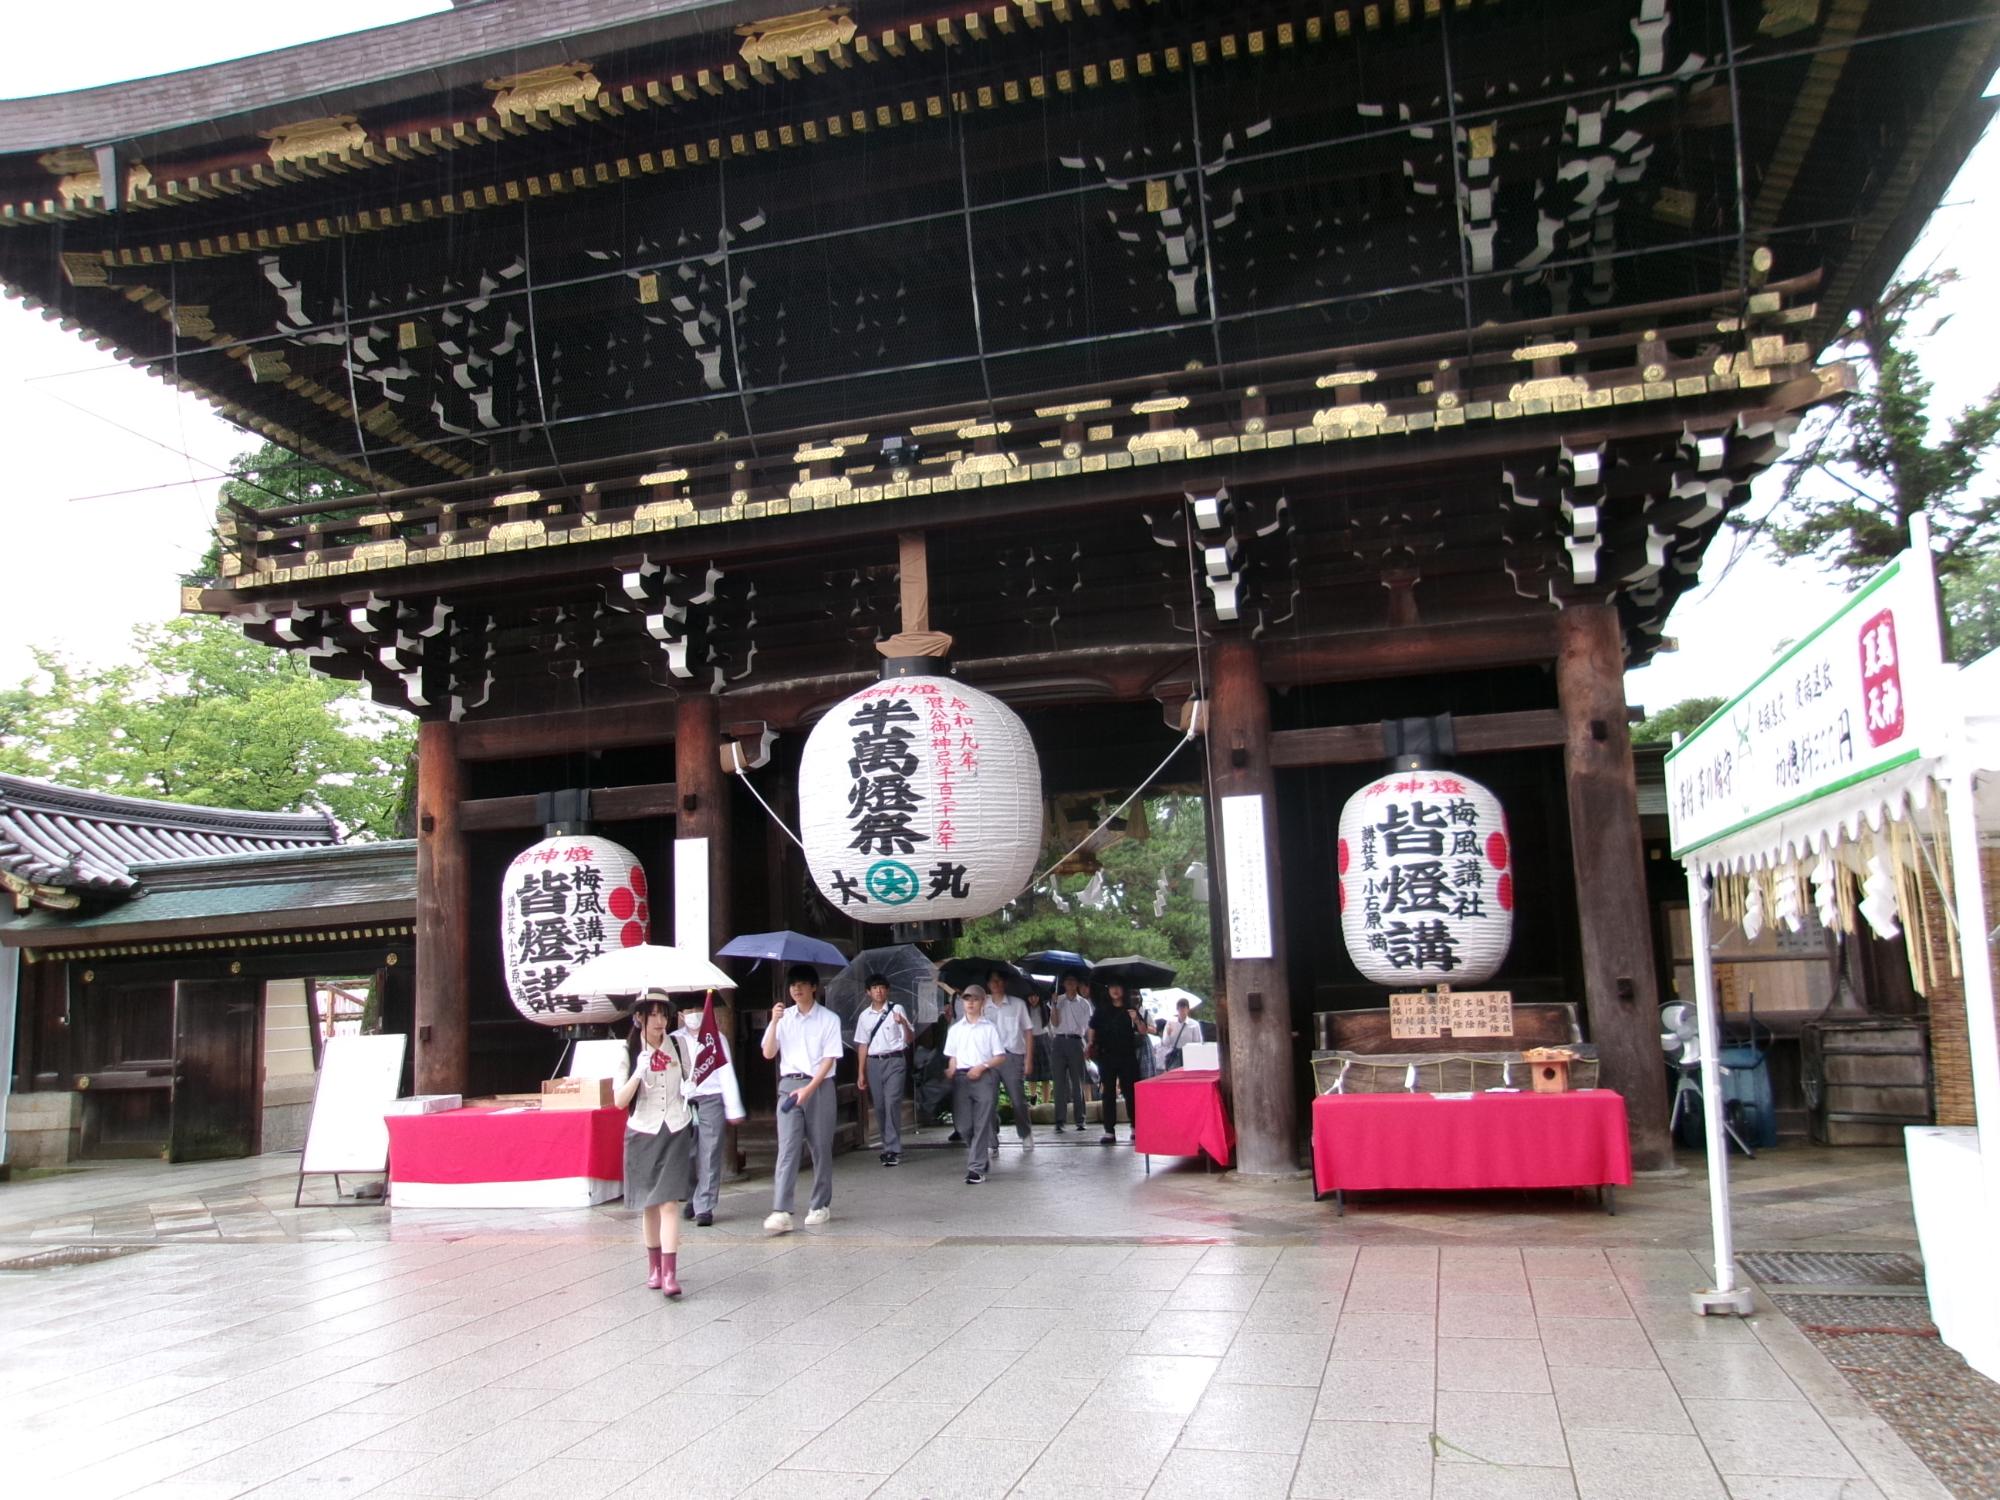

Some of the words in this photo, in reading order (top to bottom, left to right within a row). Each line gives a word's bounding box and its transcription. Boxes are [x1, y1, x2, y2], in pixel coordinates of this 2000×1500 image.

[950, 698, 979, 771] 令和九年
[846, 699, 931, 856] 半萬燈祭
[926, 862, 970, 900] 丸
[1376, 800, 1462, 971] 皆燈講
[1445, 798, 1487, 920] 梅風講社
[1452, 998, 1463, 1029] 前厄除
[1464, 998, 1475, 1028] 本厄除
